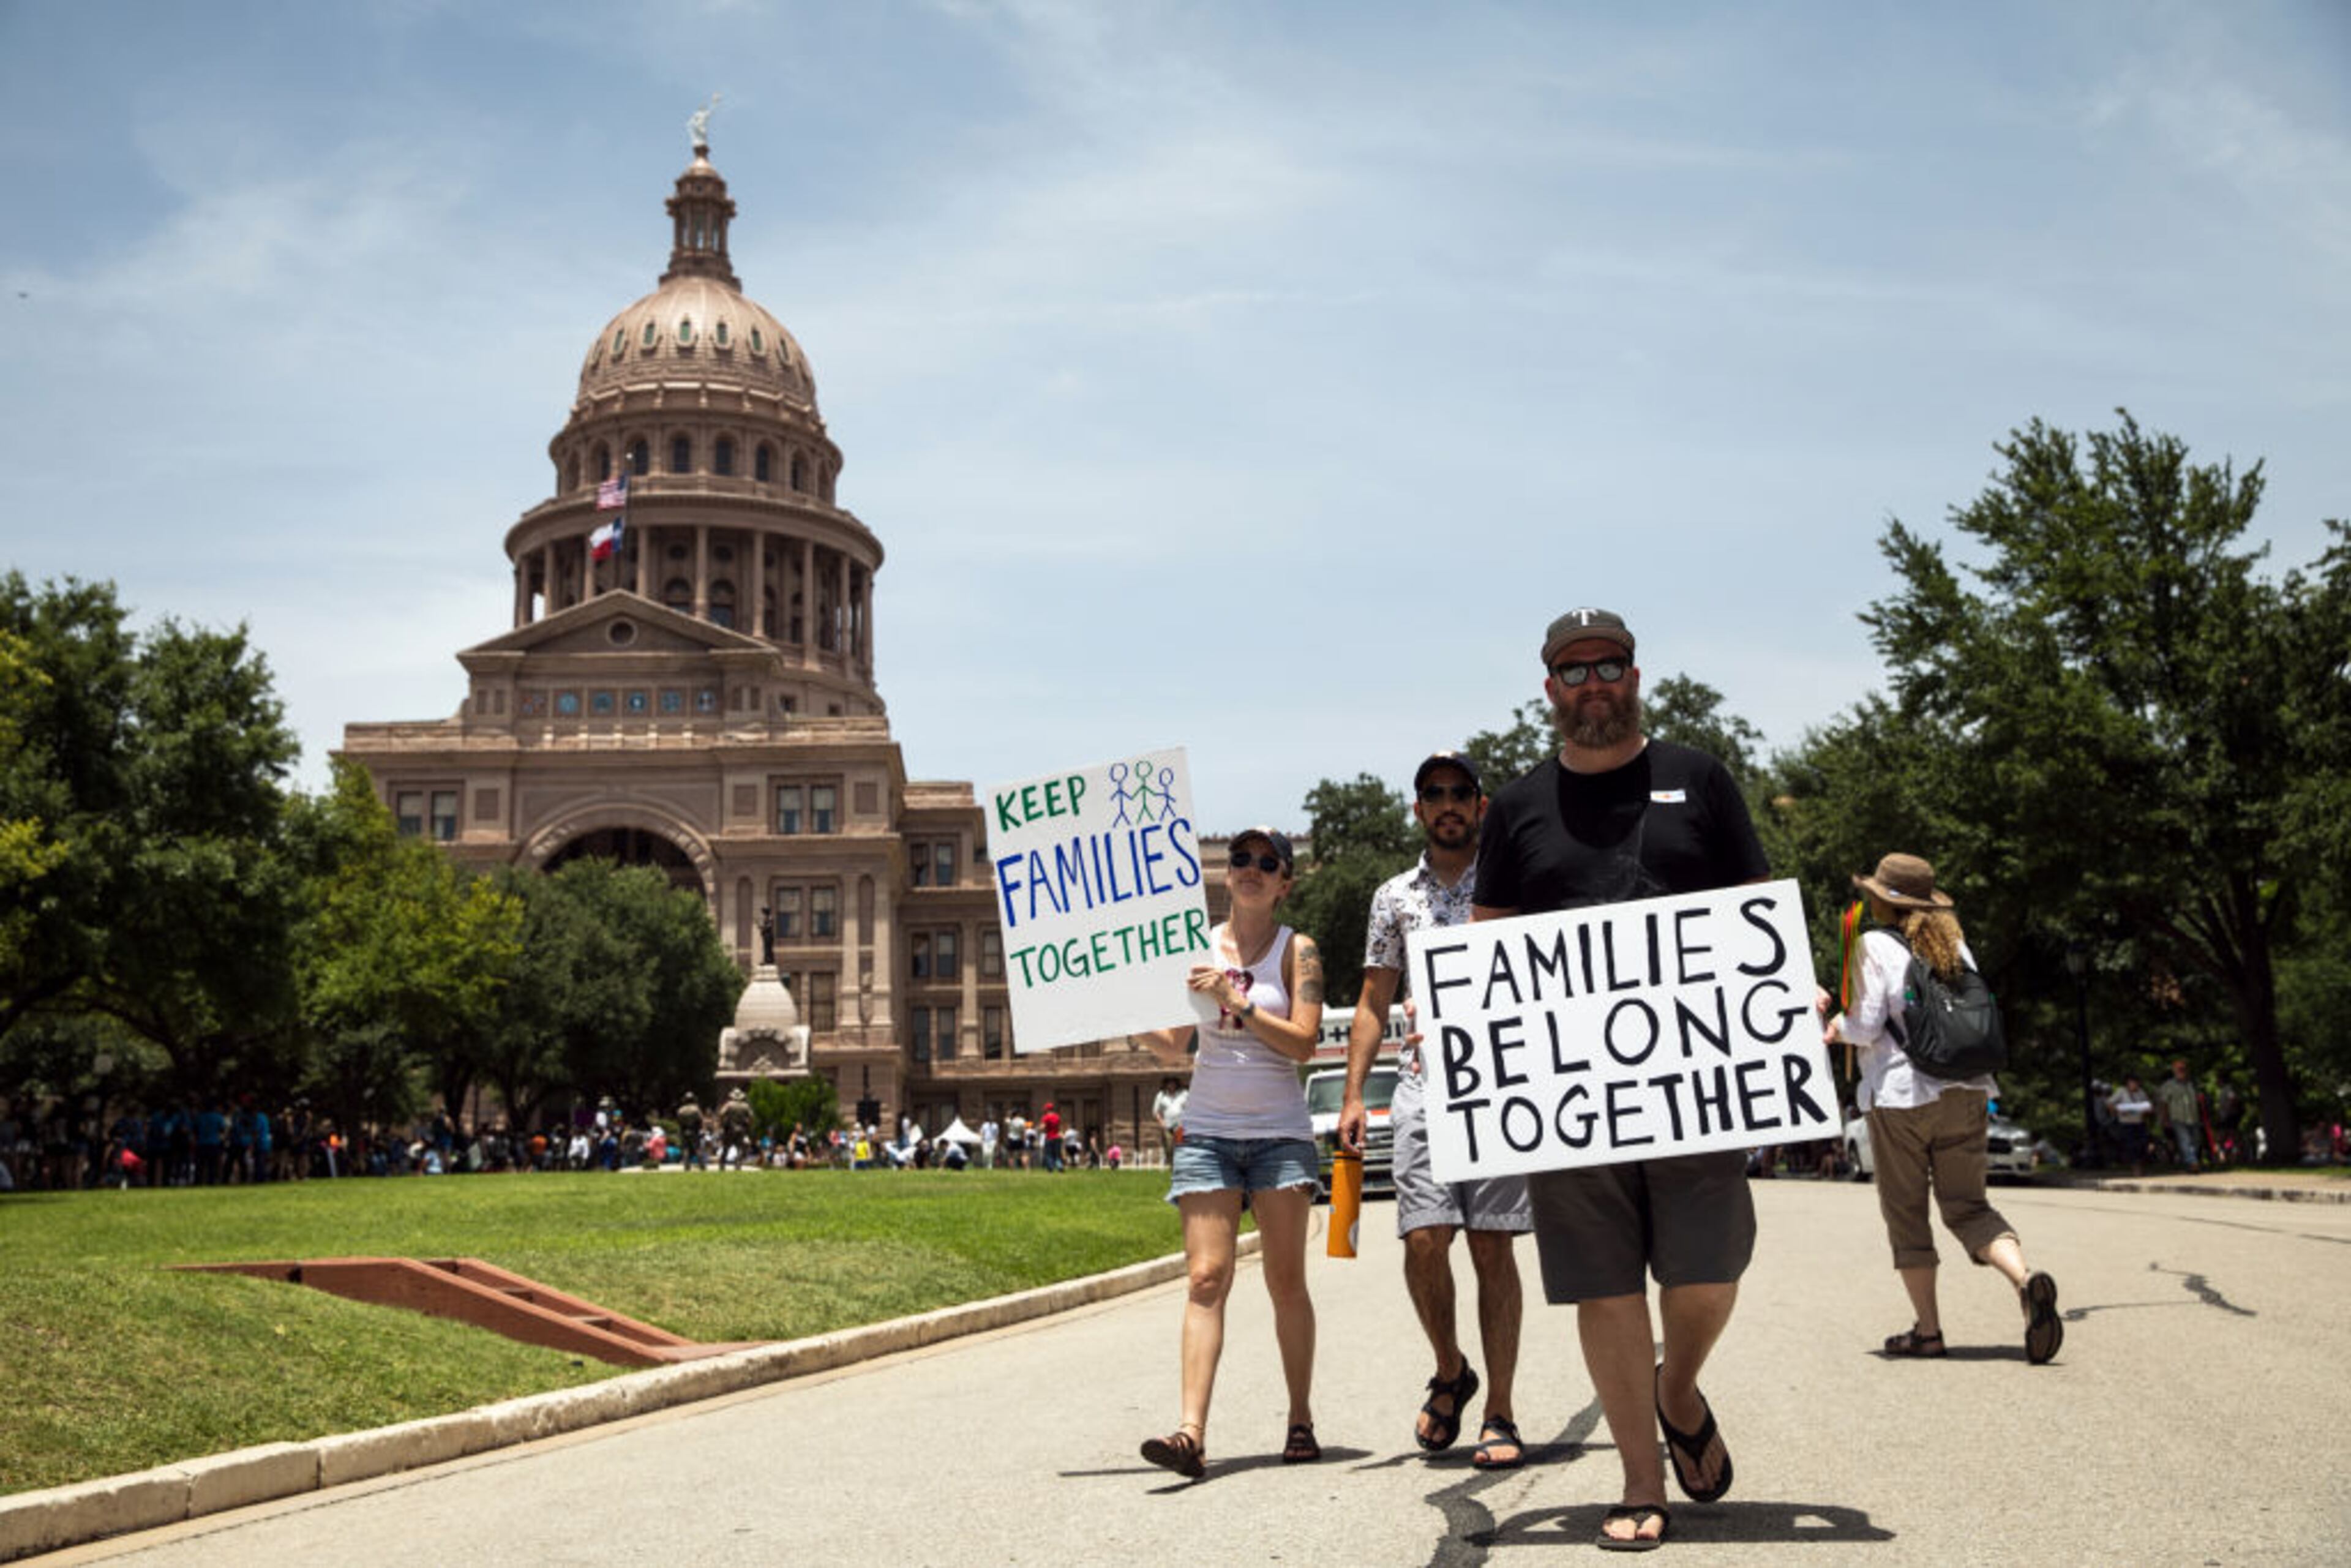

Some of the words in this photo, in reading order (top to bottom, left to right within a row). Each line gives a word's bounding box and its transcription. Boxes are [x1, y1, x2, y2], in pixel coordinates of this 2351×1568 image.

[1572, 608, 1599, 626] T
[996, 775, 1086, 832] KEEP
[996, 818, 1200, 928] FAMILIES
[1010, 908, 1210, 988] TOGETHER
[1425, 898, 1787, 1019] FAMILIES
[1441, 980, 1809, 1100] BELONG
[1446, 1054, 1828, 1163] TOGETHER
